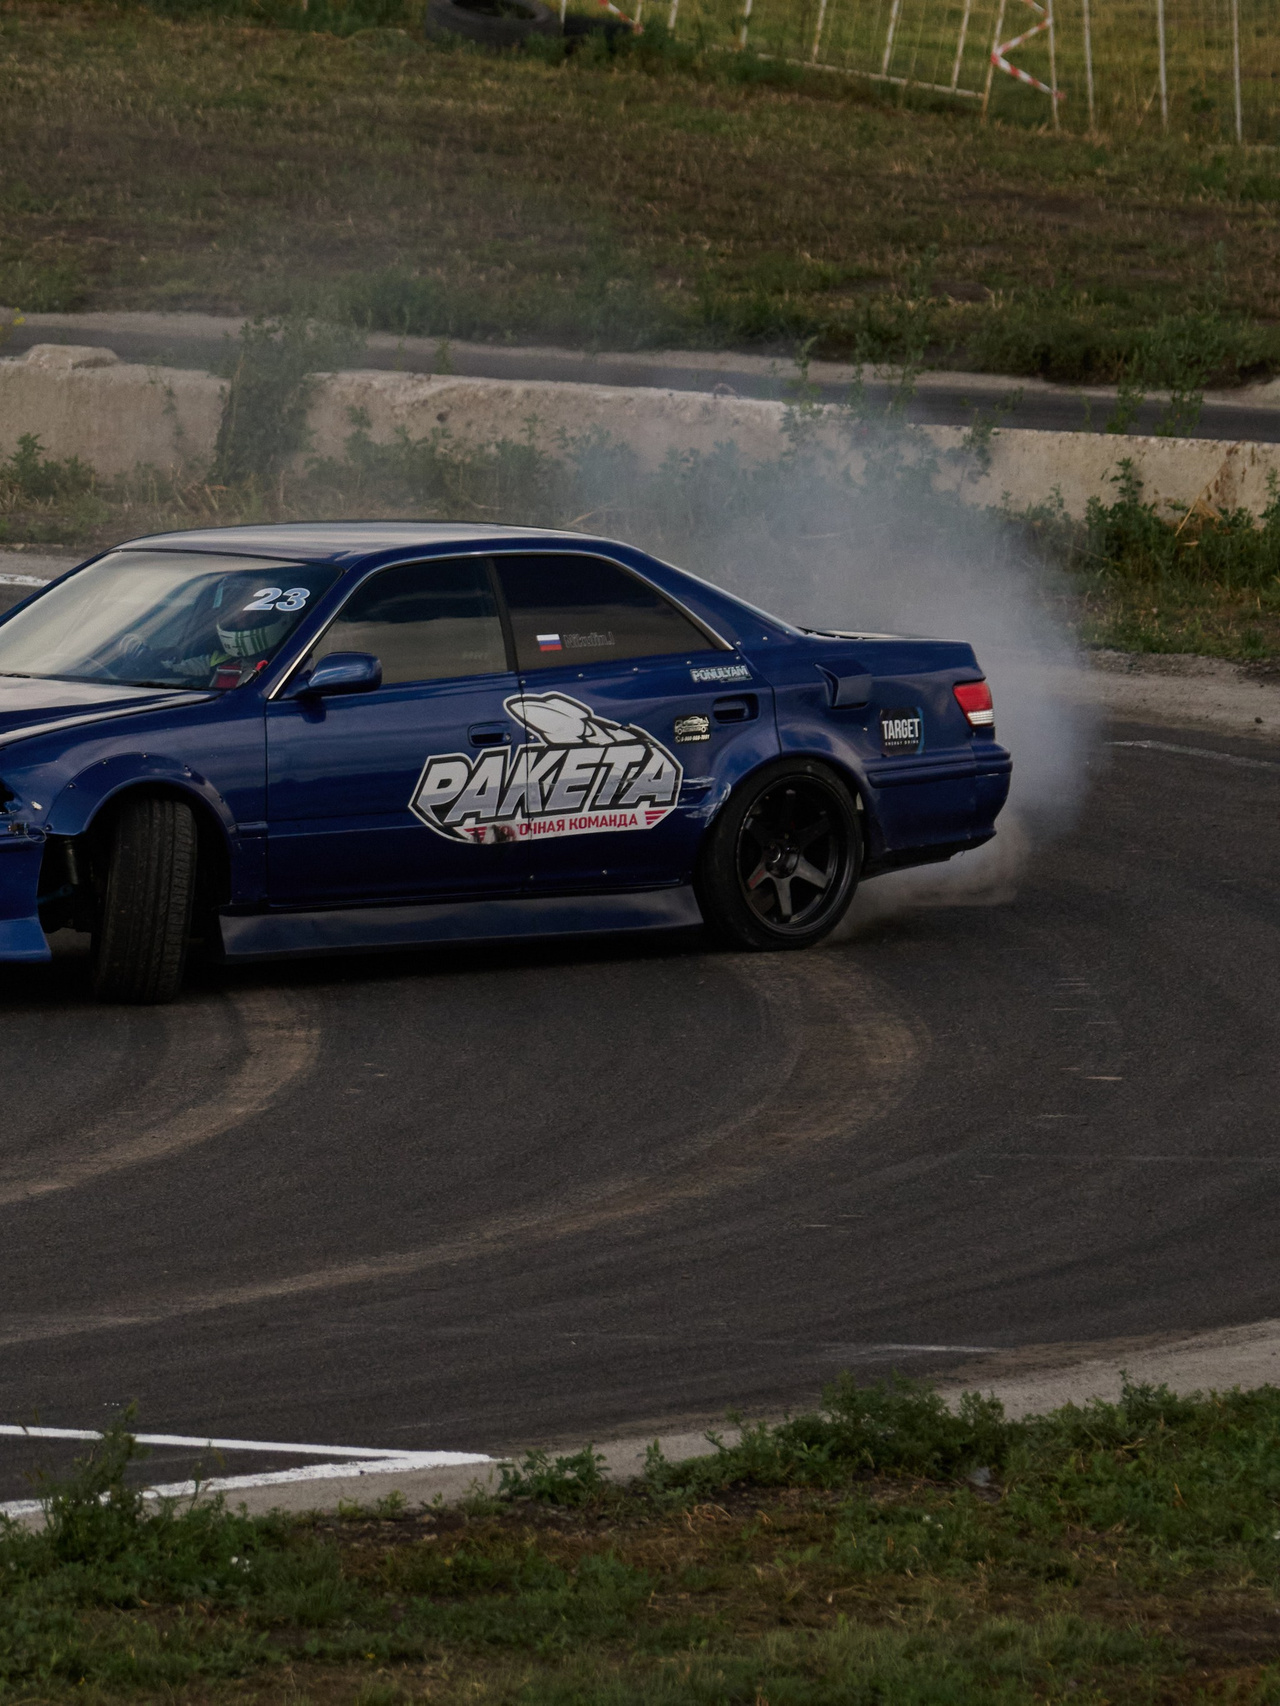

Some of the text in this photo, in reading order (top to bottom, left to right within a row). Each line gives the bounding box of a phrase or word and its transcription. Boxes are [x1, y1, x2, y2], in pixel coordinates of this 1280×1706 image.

[243, 587, 311, 612] 23
[882, 718, 920, 739] TARGET
[416, 745, 677, 823] РАКЕТА
[569, 813, 638, 831] КОМАНДА
